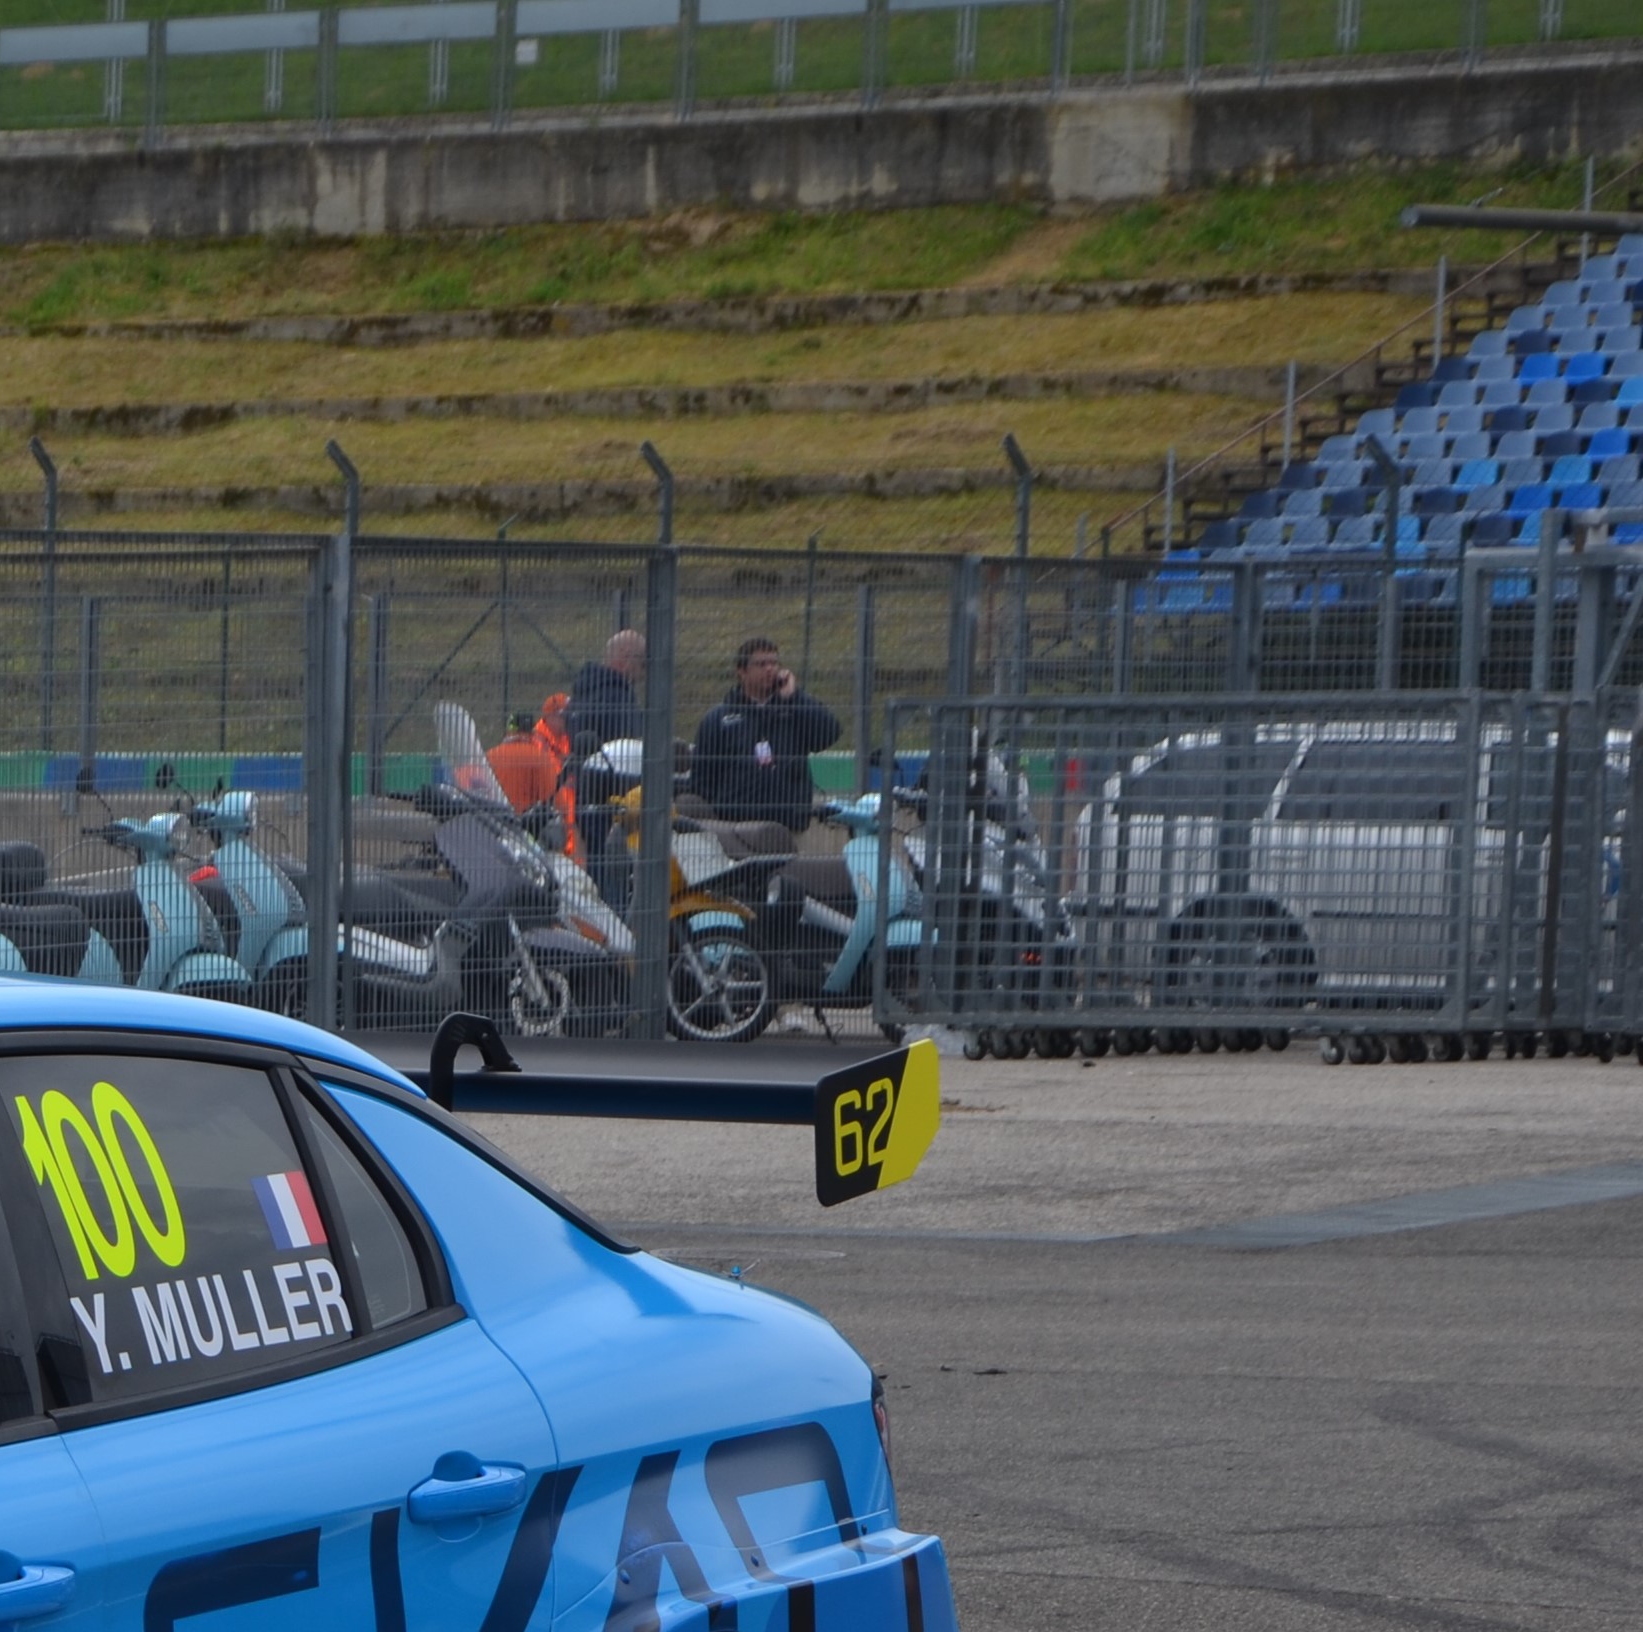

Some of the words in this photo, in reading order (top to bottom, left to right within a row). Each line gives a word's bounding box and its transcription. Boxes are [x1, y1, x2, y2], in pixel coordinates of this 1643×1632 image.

[15, 1081, 187, 1281] 100
[833, 1076, 895, 1177] 62
[70, 1292, 133, 1375] Y.
[131, 1257, 354, 1366] MULLER
